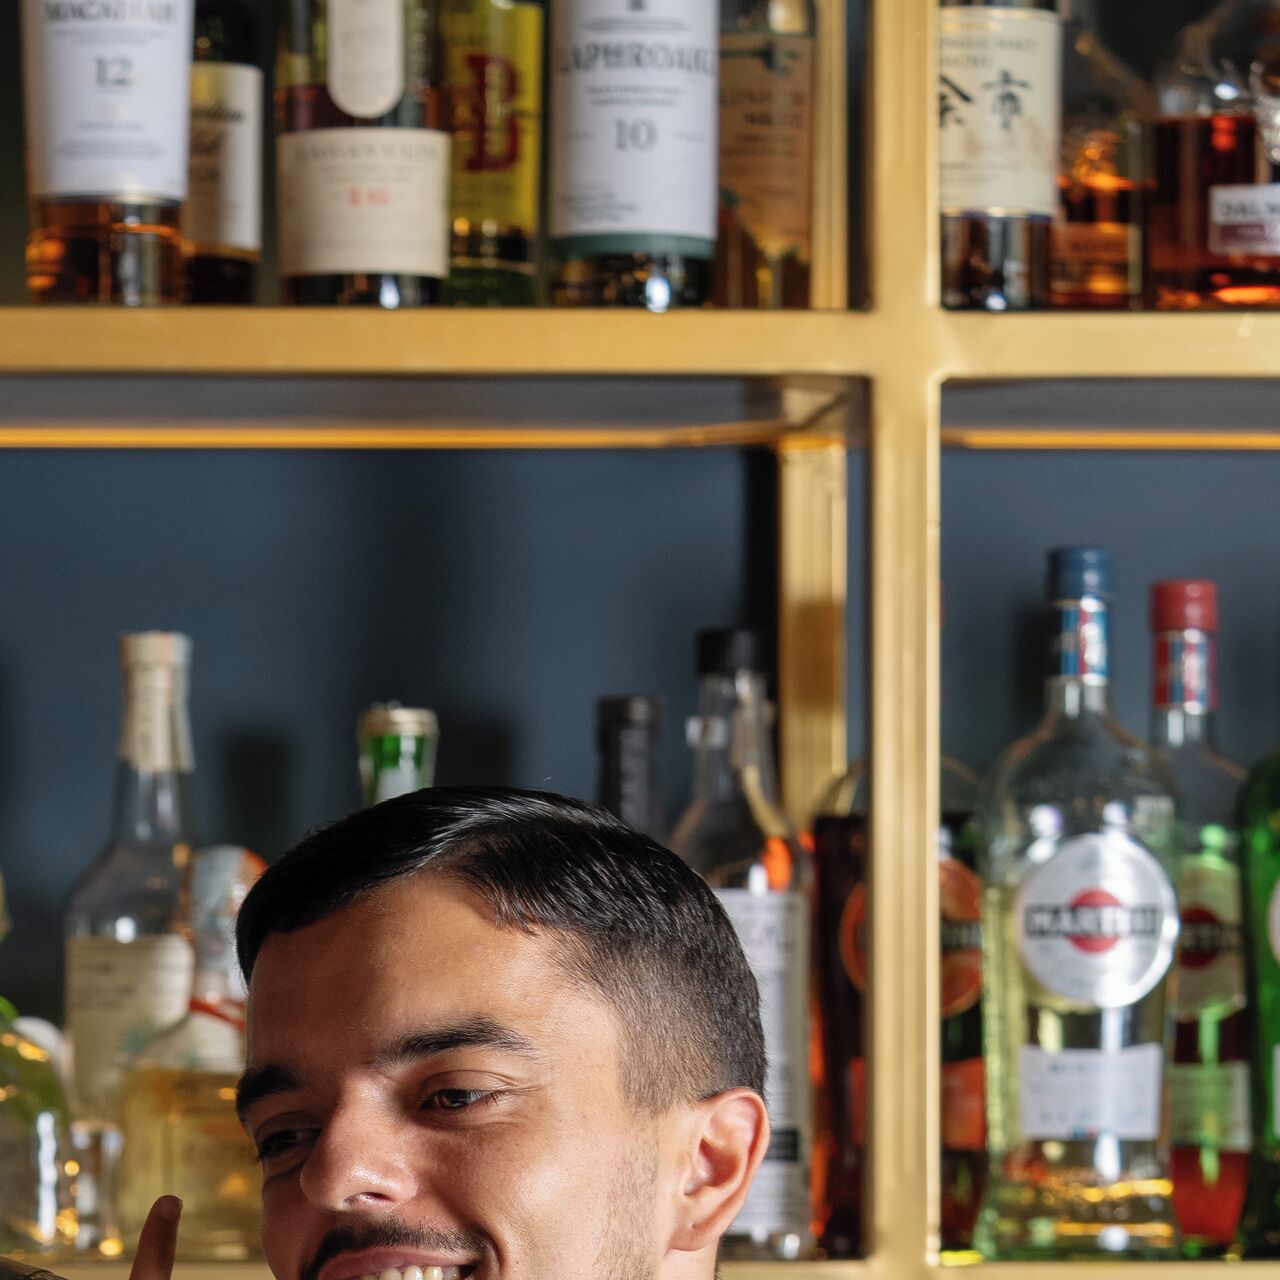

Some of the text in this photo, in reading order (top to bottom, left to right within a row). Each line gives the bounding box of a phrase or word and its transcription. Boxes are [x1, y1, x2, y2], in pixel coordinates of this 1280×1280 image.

[94, 55, 133, 87] 12
[614, 118, 659, 152] 10
[1027, 906, 1157, 939] MARTINI
